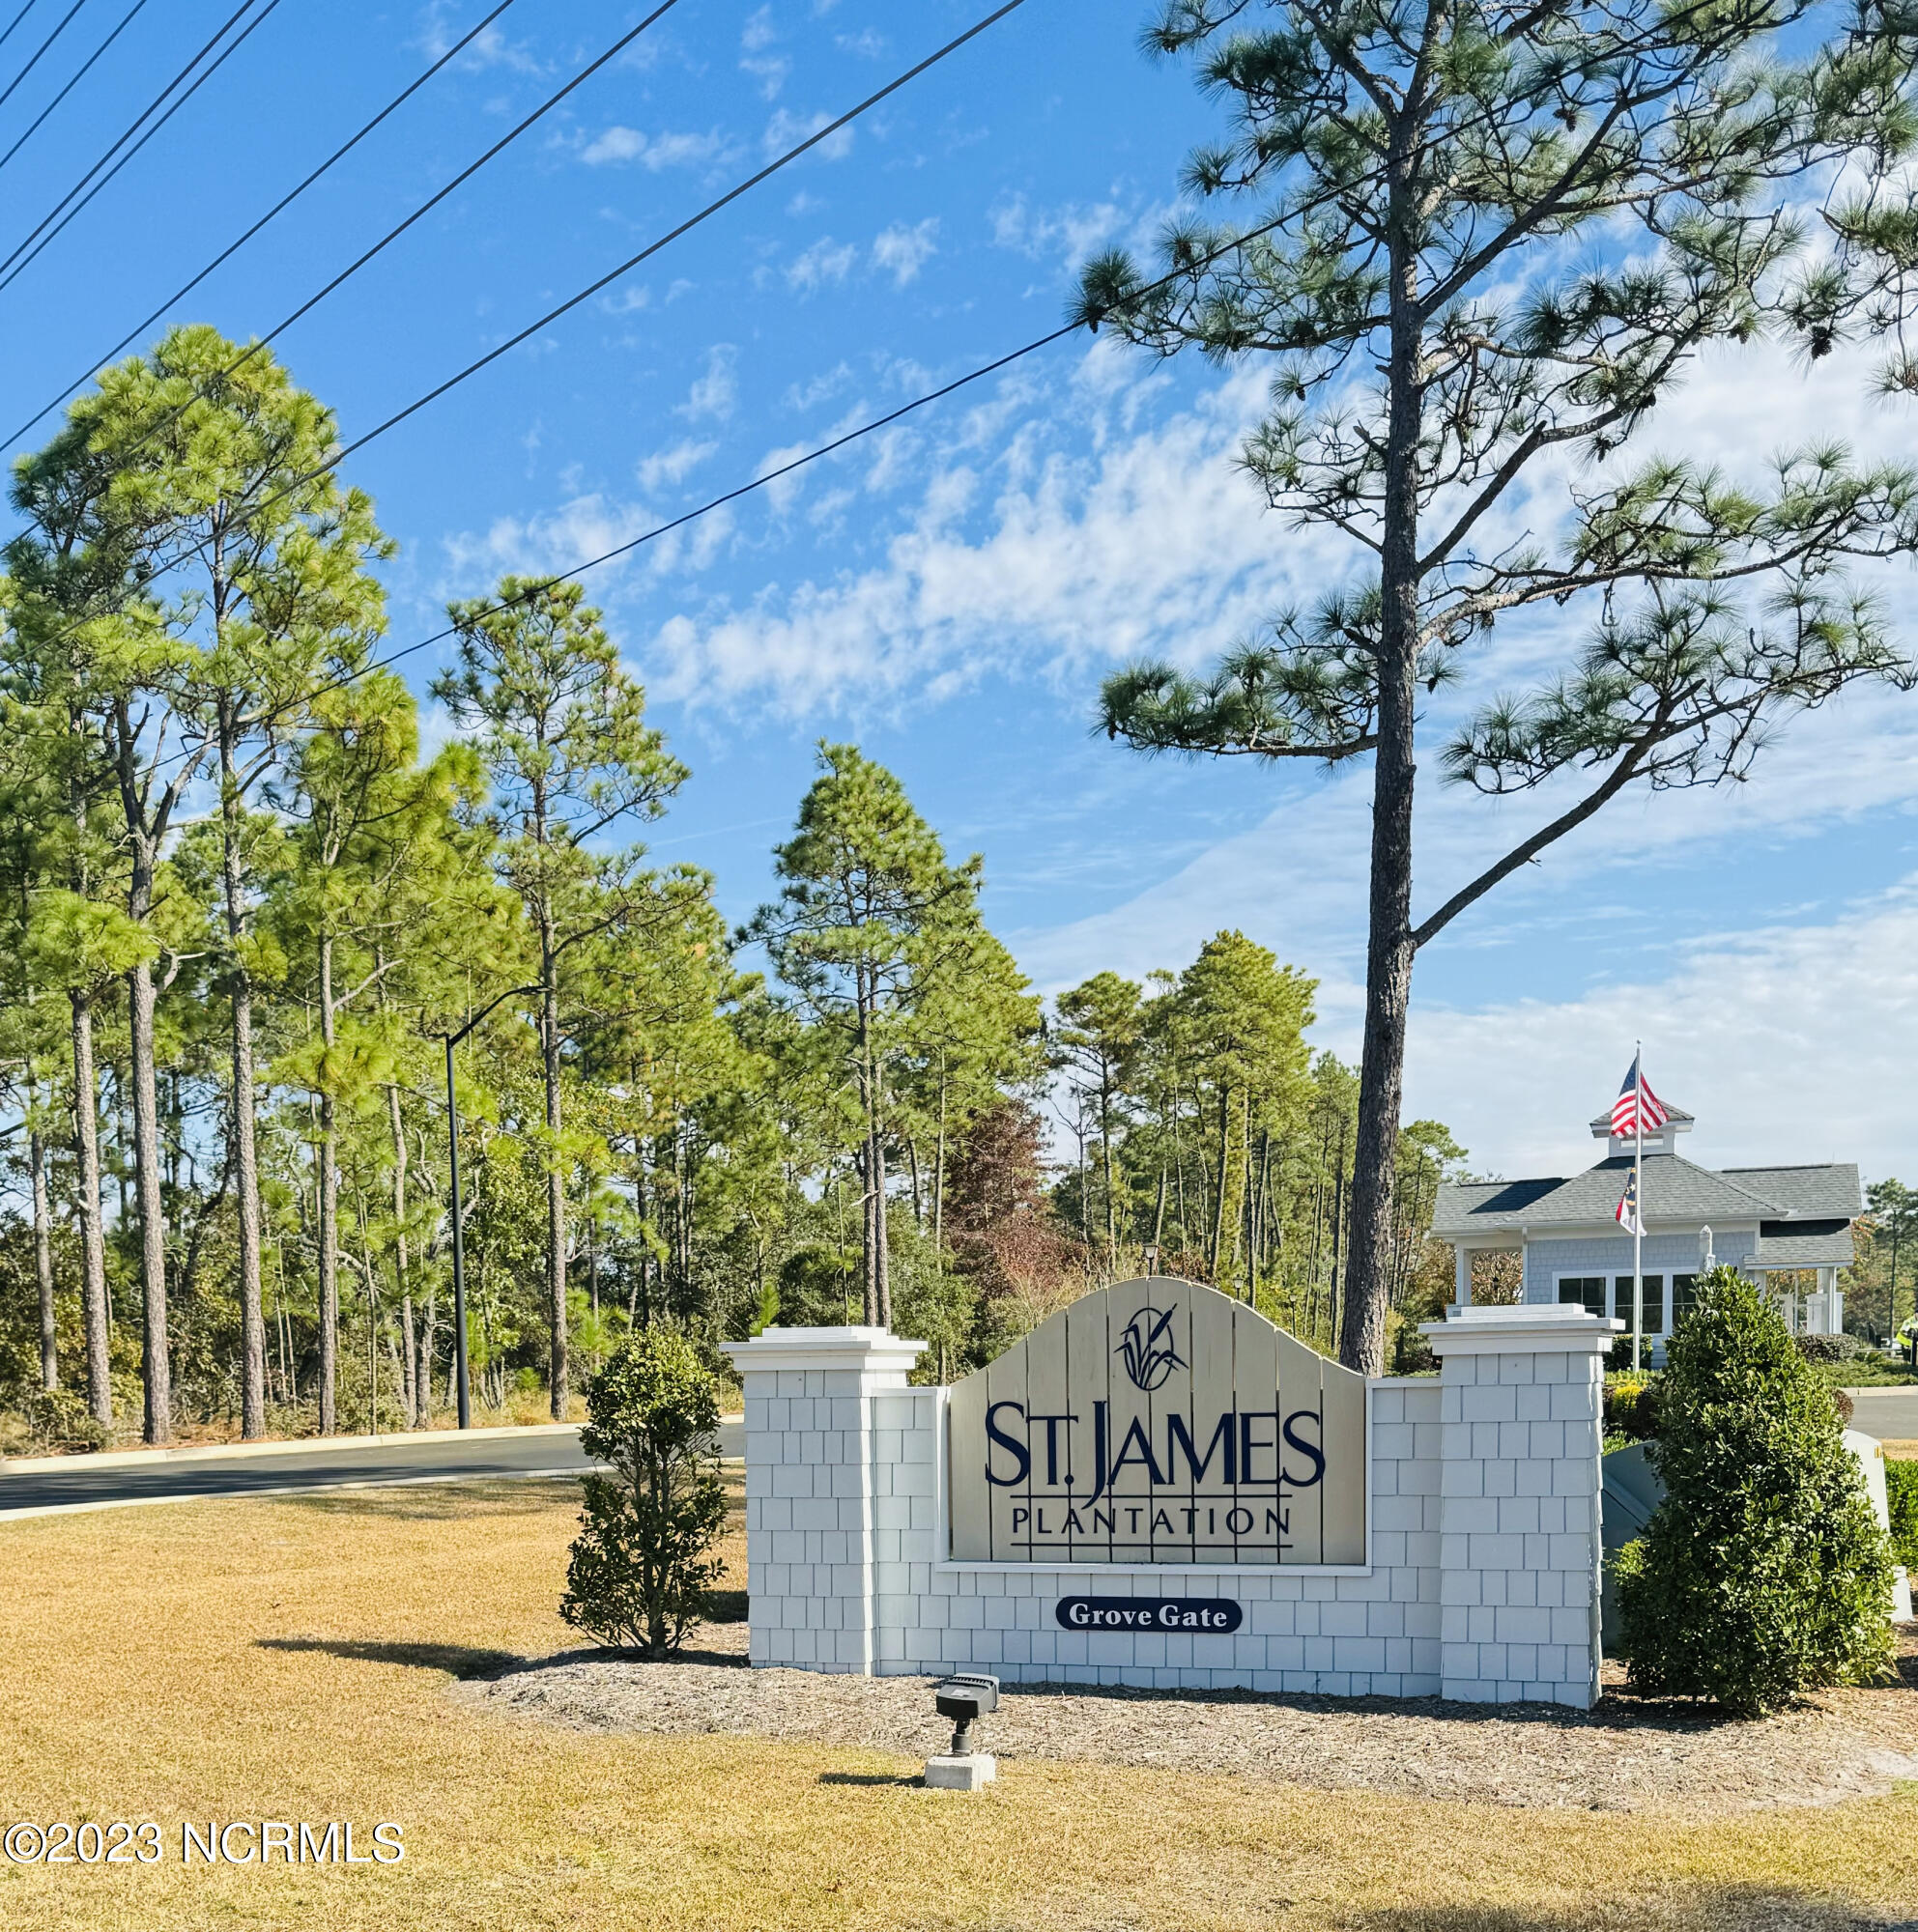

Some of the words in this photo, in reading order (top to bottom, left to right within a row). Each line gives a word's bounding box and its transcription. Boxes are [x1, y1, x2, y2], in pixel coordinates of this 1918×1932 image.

[1013, 1507, 1290, 1535] PLANTATION
[1069, 1603, 1152, 1626] Grove
[1159, 1605, 1227, 1628] Gate
